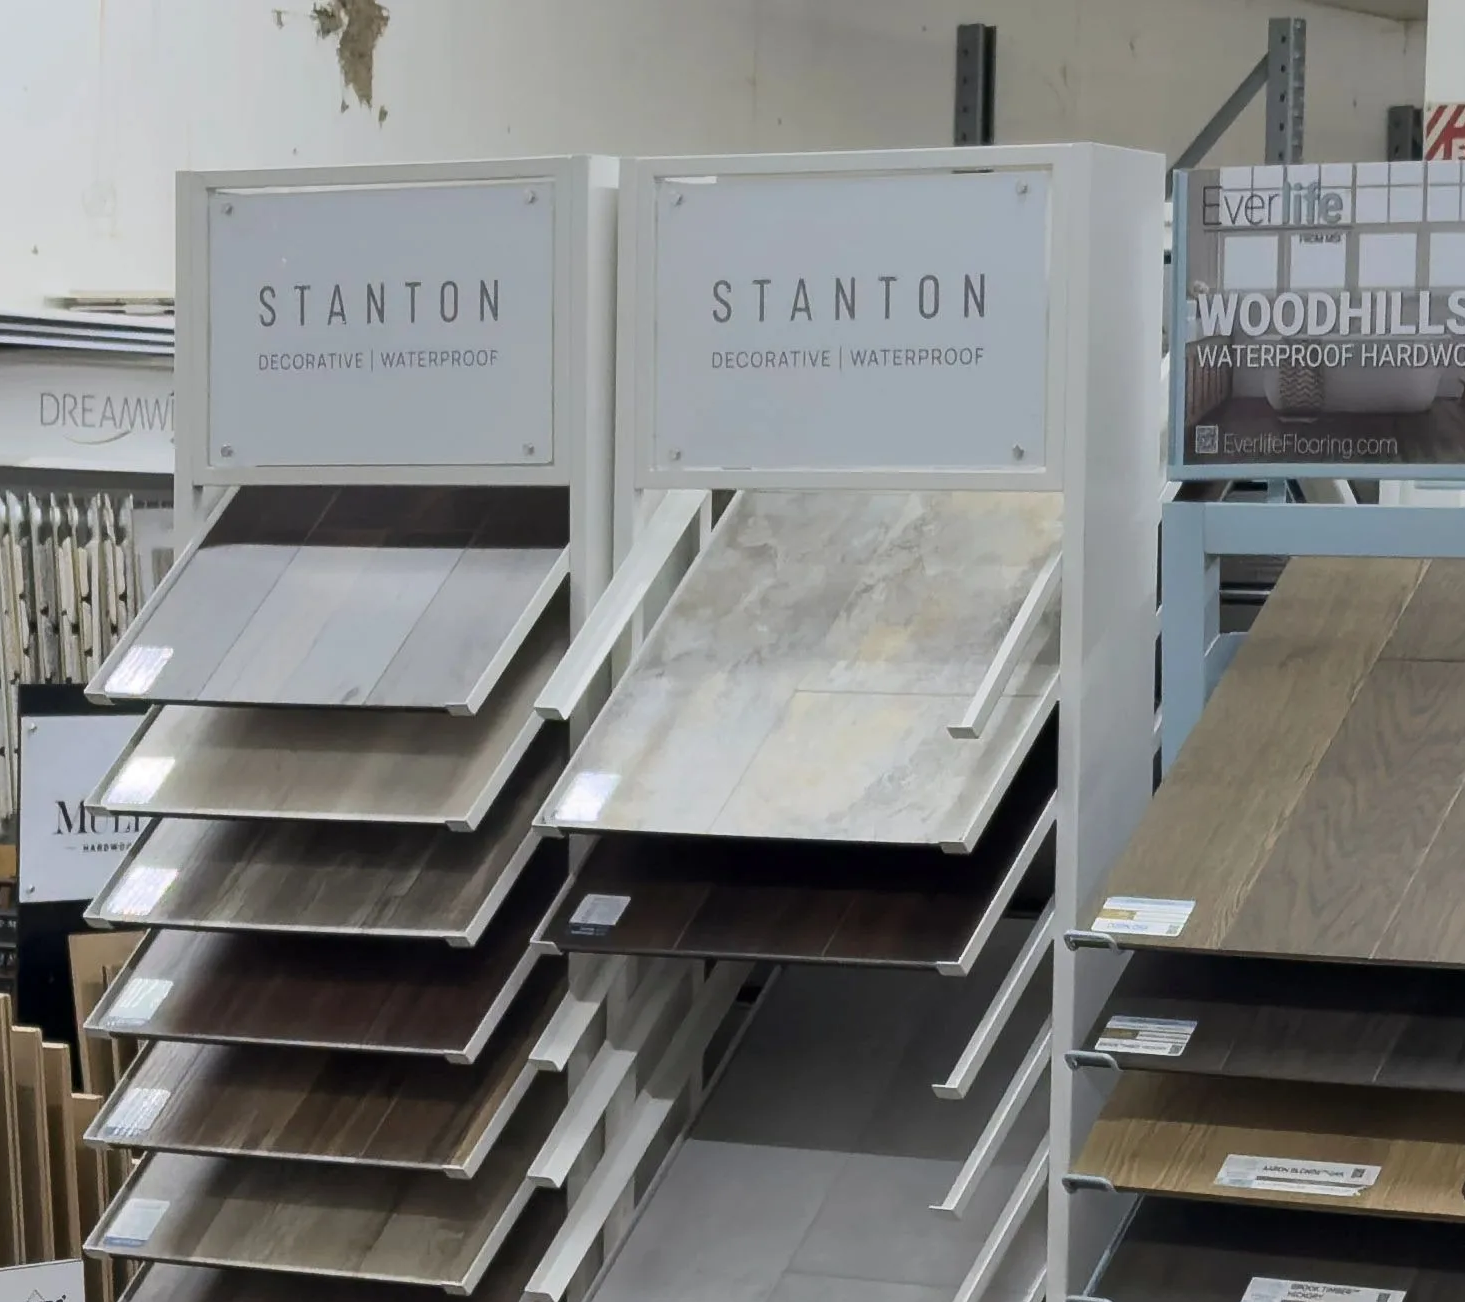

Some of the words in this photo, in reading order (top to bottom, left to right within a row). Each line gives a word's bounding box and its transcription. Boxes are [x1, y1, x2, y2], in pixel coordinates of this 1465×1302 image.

[1203, 180, 1344, 225] Everlife
[258, 279, 500, 327] STANTON
[712, 273, 987, 323] STANTON
[258, 350, 364, 372] DECORATIVE
[380, 348, 499, 369] WATERPROOF
[711, 347, 831, 370] DECORATIVE
[850, 346, 985, 367] WATERPROOF
[1197, 343, 1352, 369] WATERPROOF
[1223, 433, 1398, 458] EverlifeFlooring.com
